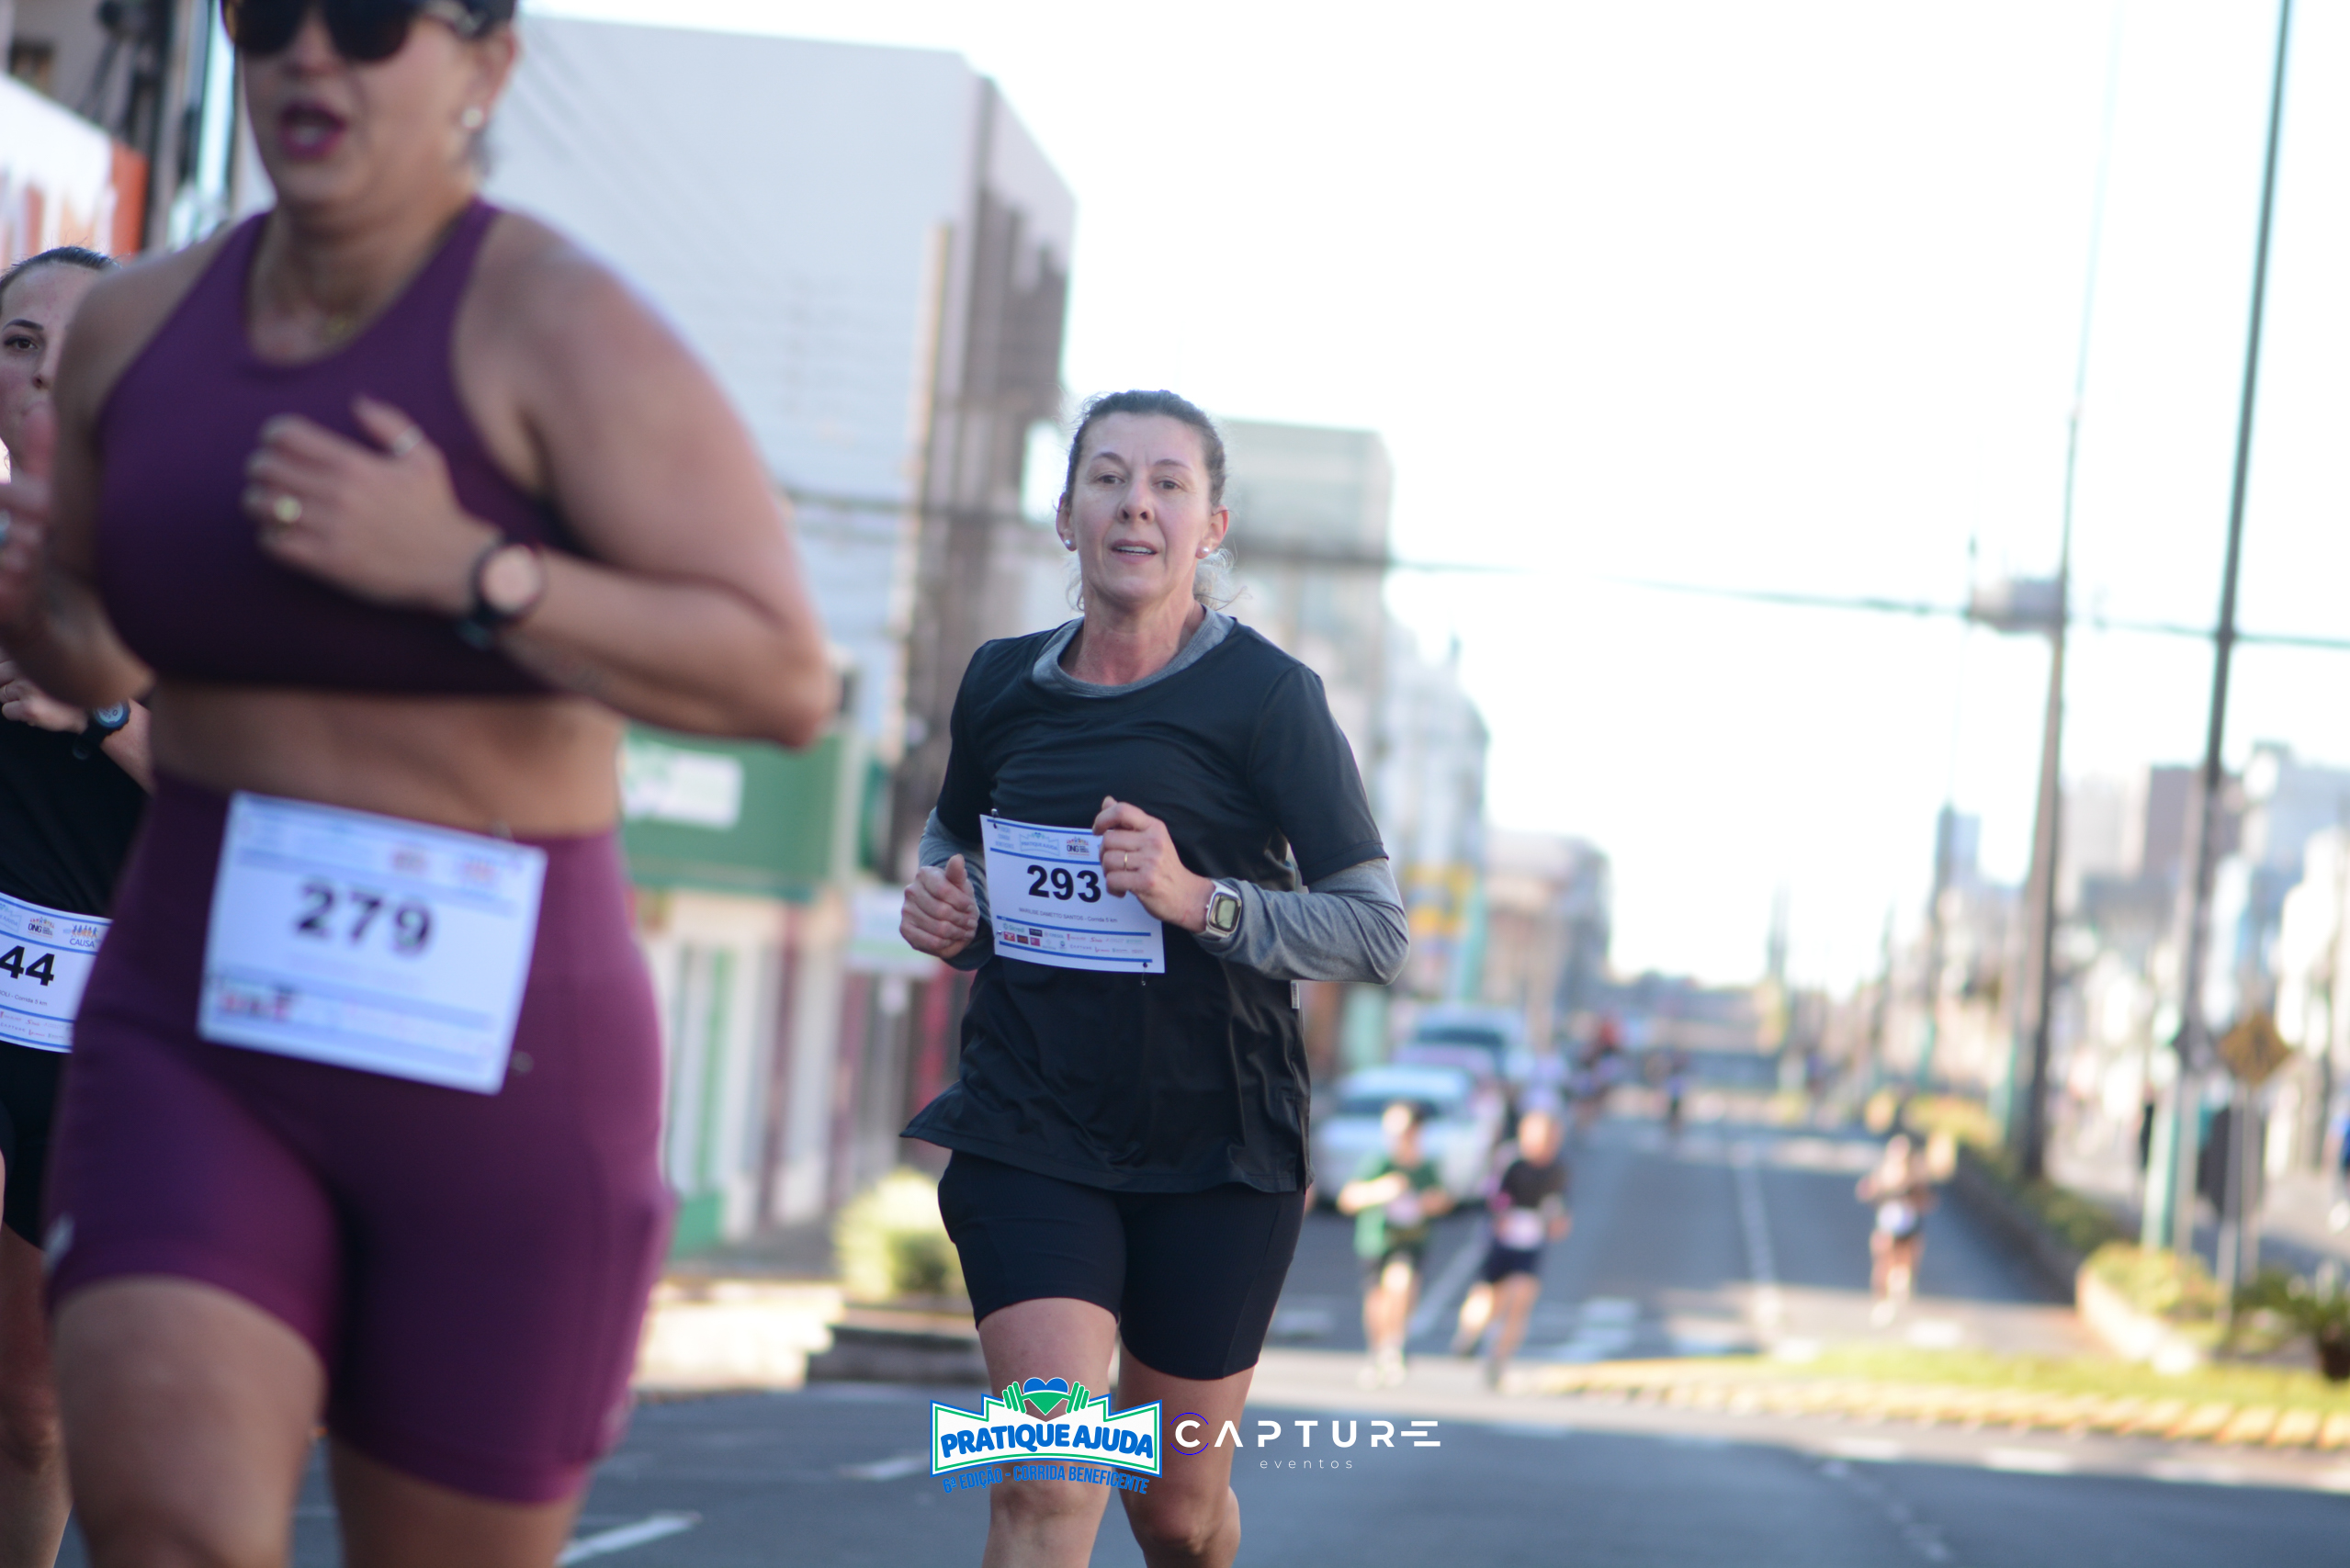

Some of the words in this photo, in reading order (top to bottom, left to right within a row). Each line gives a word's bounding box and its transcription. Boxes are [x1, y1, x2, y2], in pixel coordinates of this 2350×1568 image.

[1066, 844, 1079, 852] ONG
[1027, 864, 1102, 903] 293
[294, 879, 434, 958] 279
[28, 922, 42, 933] ONG
[70, 938, 96, 948] CAUSA
[15, 994, 34, 1003] Corrida
